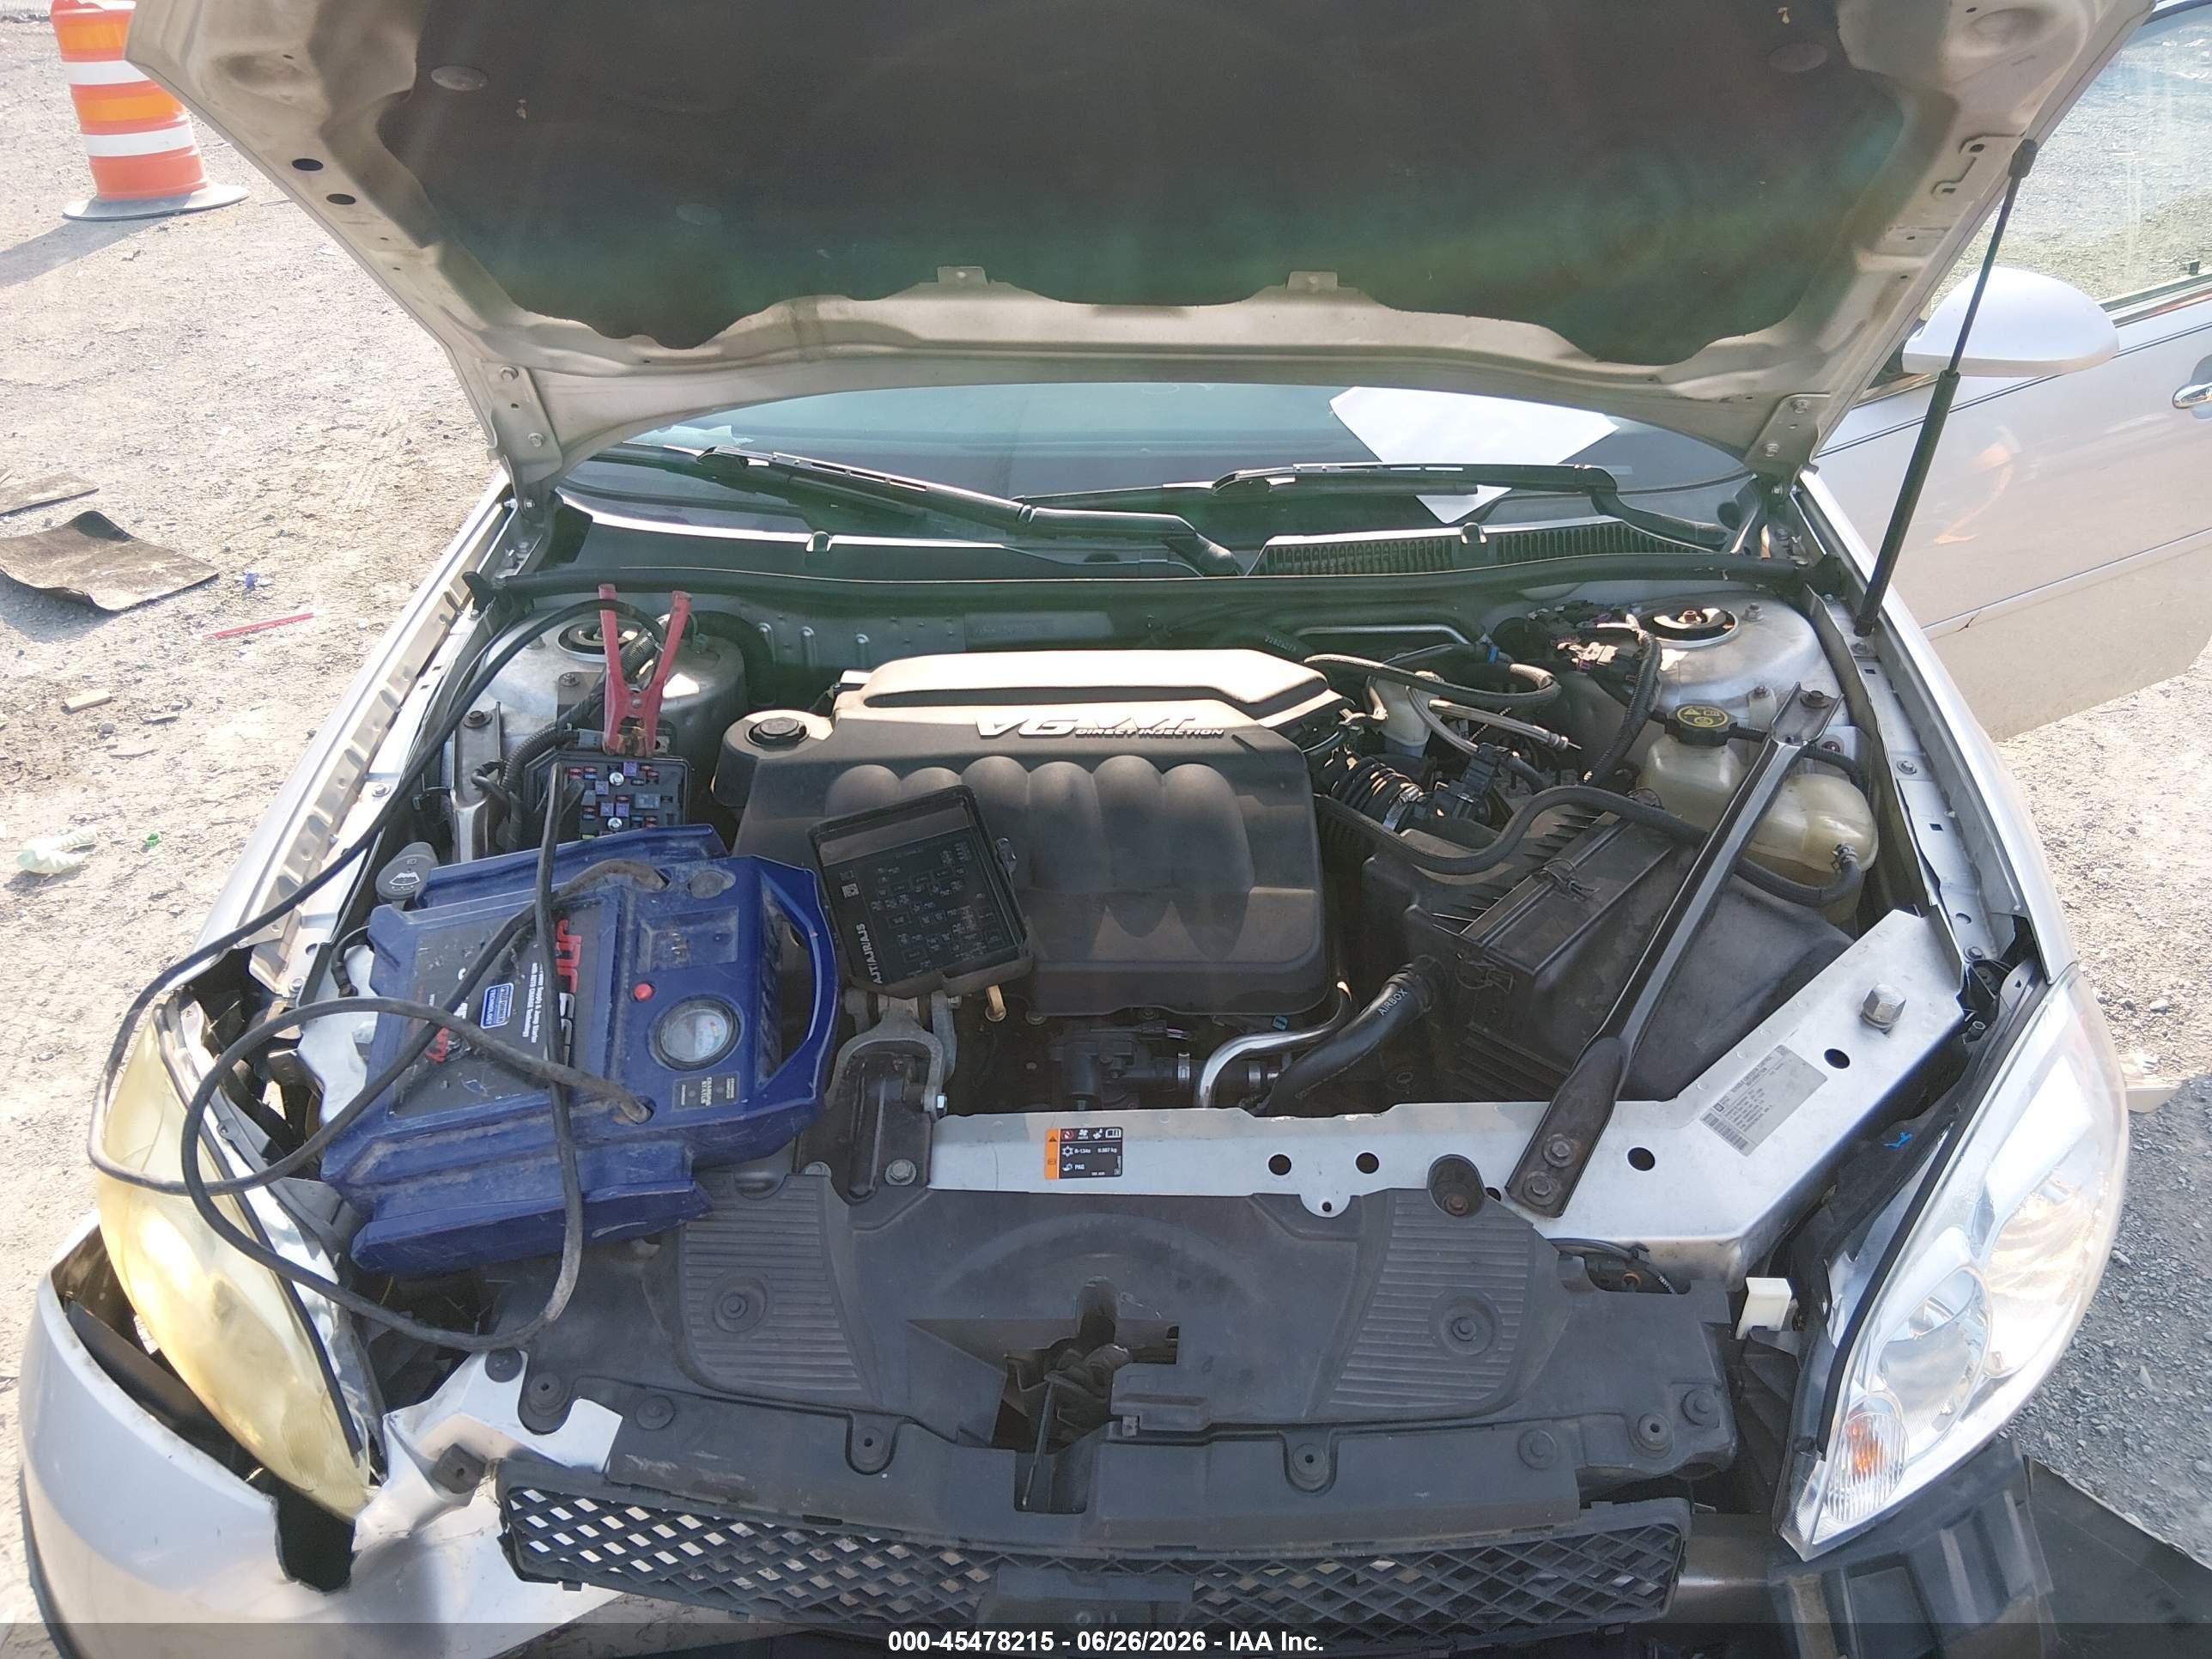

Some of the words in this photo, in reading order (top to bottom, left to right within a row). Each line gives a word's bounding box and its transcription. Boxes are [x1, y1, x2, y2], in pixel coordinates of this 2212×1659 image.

[975, 714, 1079, 738] V6
[1075, 728, 1137, 738] DIRECT
[1138, 728, 1224, 738] INJECTION
[856, 923, 884, 984] AJT/AJR/AJS
[486, 988, 496, 1024] TECHNOLOGY
[527, 988, 536, 1008] CHARGE
[1378, 988, 1408, 1016] AIRBOX
